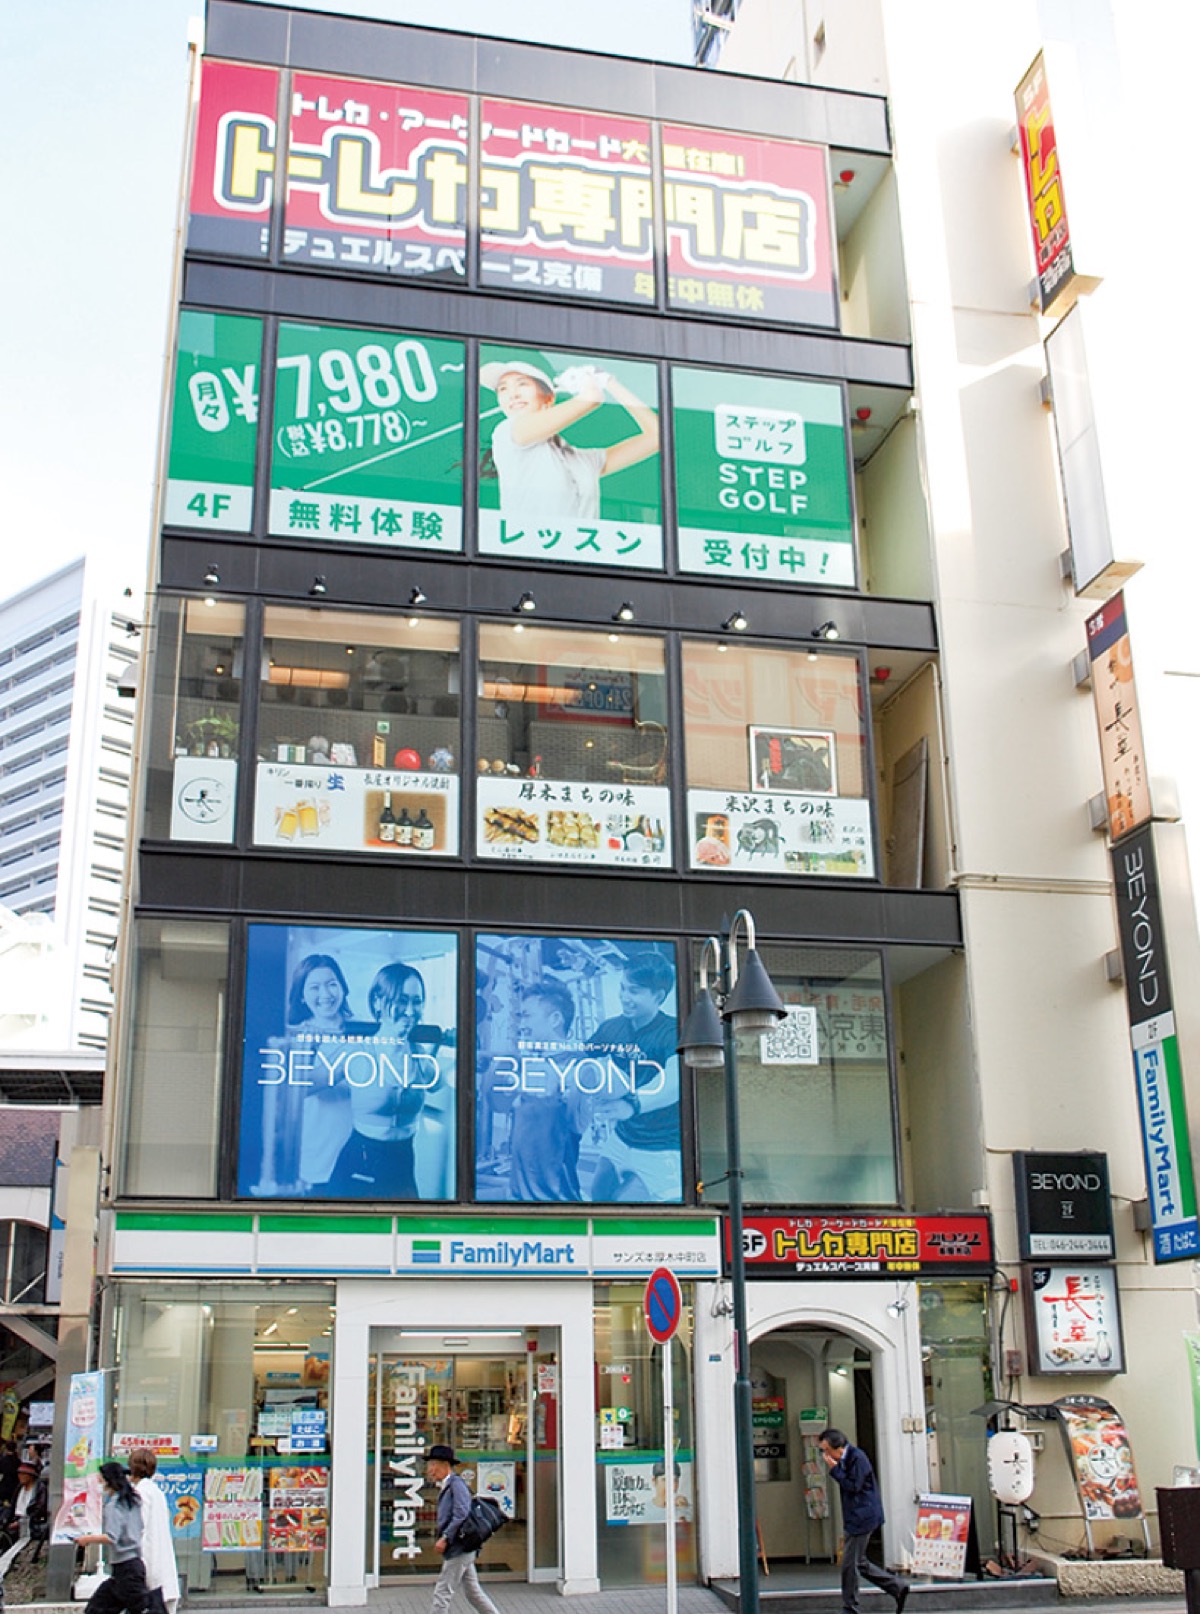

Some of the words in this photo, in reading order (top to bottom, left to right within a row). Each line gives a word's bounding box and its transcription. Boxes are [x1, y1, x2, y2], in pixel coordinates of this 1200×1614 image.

[1027, 106, 1064, 242] トレカ
[229, 124, 802, 268] トレカ専門店
[197, 381, 221, 421] 月々
[725, 414, 798, 433] ステップ
[726, 434, 795, 456] ゴルフ
[719, 463, 807, 491] STEP
[719, 489, 808, 515] GOLF
[187, 493, 232, 519] 4F
[288, 499, 444, 542] 無料体験
[500, 518, 642, 556] レッスン
[703, 537, 831, 576] 受付中!
[327, 772, 346, 792] 生
[517, 782, 636, 806] 厚木まちの味
[724, 795, 835, 817] 米沢まちの味
[1124, 846, 1159, 1007] BEYOND
[257, 1048, 440, 1089] BEYOND
[492, 1056, 666, 1095] BEYOND
[1143, 1049, 1175, 1217] FamilyMart
[1030, 1173, 1101, 1190] BEYOND
[450, 1241, 575, 1266] FamilyMart
[773, 1230, 918, 1258] トレカ専門店
[389, 1365, 425, 1560] FamilyMart
